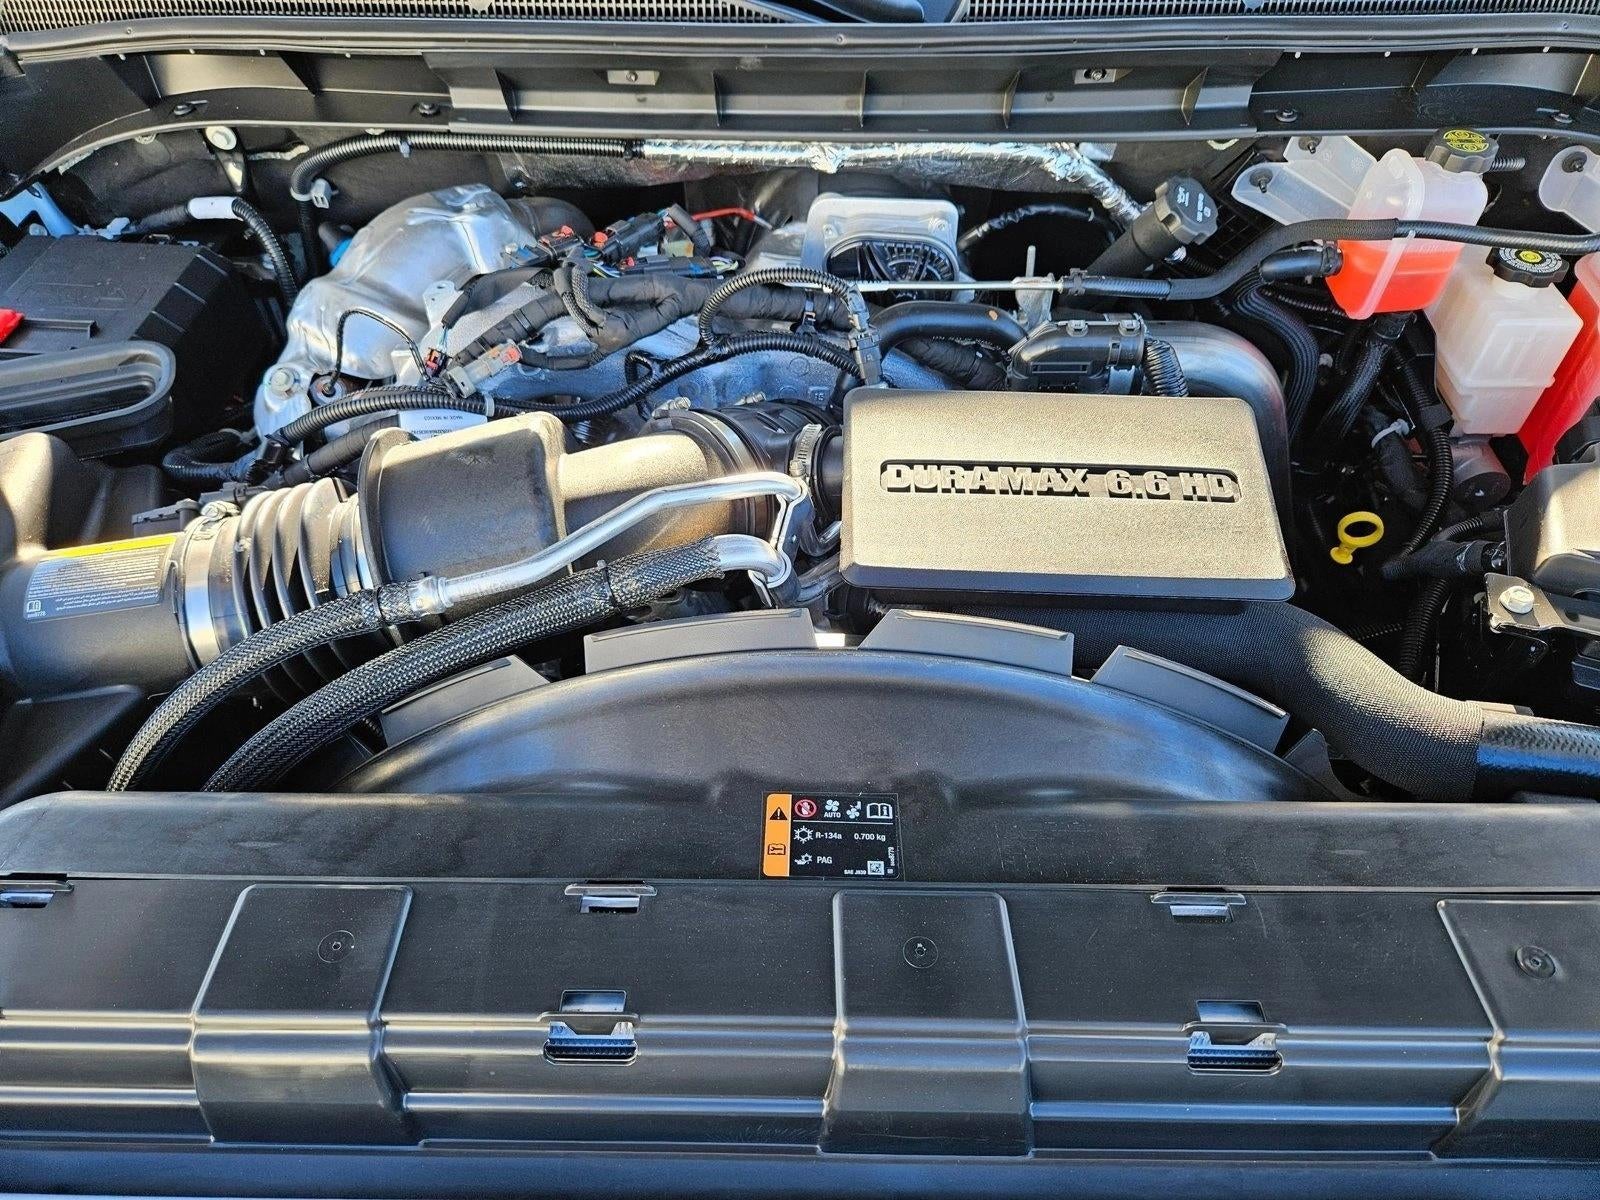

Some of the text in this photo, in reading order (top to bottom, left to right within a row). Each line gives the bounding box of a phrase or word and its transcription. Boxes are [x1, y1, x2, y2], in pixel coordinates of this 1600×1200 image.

[886, 464, 1237, 503] DURAMAX 6.6 HD
[815, 832, 886, 842] R-134a 0.700 kg
[816, 856, 833, 864] PAG
